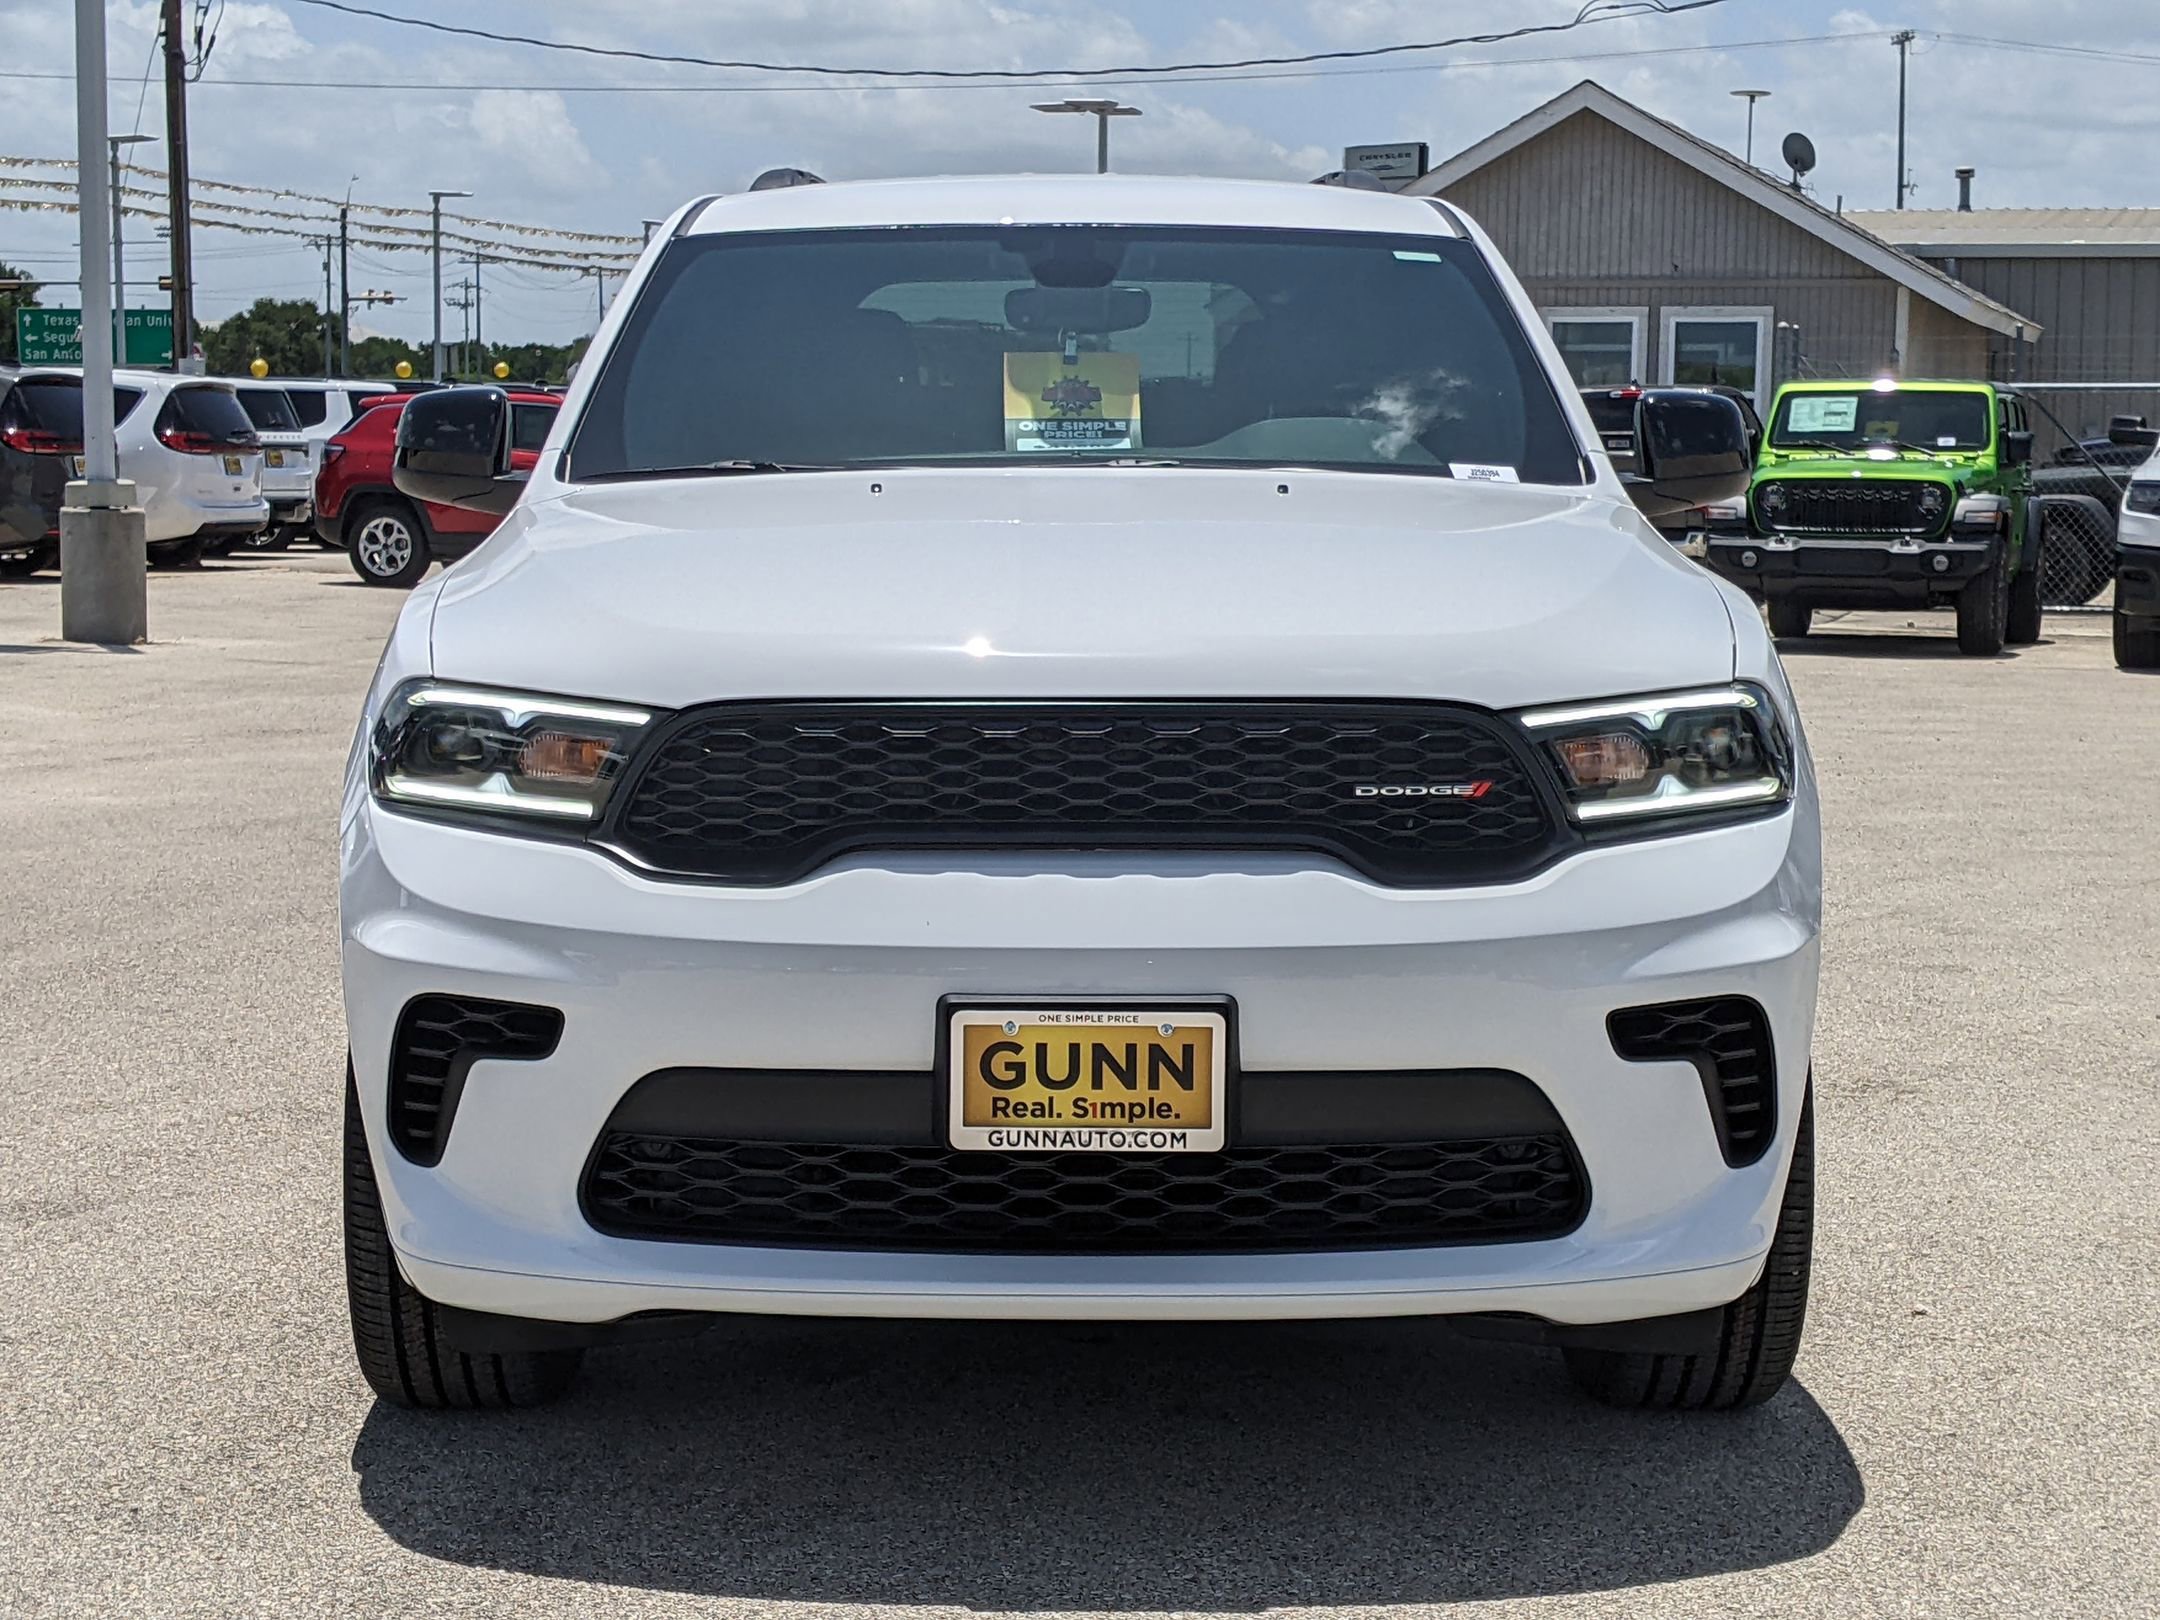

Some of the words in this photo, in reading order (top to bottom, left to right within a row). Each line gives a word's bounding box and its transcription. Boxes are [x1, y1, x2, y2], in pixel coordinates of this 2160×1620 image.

[1359, 152, 1412, 162] CHRYSLER
[42, 313, 80, 326] Texas
[42, 331, 75, 346] Segu
[25, 348, 48, 360] San
[52, 348, 82, 360] Anto
[1018, 421, 1057, 432] ONE
[1061, 421, 1127, 431] SIMPLE
[1043, 430, 1103, 439] PRICE!
[1355, 785, 1474, 796] DODGE
[1038, 1014, 1062, 1023] ONE
[1065, 1014, 1104, 1024] SIMPLE
[1107, 1015, 1139, 1024] PRICE
[979, 1040, 1194, 1091] GUNN
[991, 1096, 1062, 1119] Real.
[988, 1129, 1187, 1149] GUNNAUTO.COM
